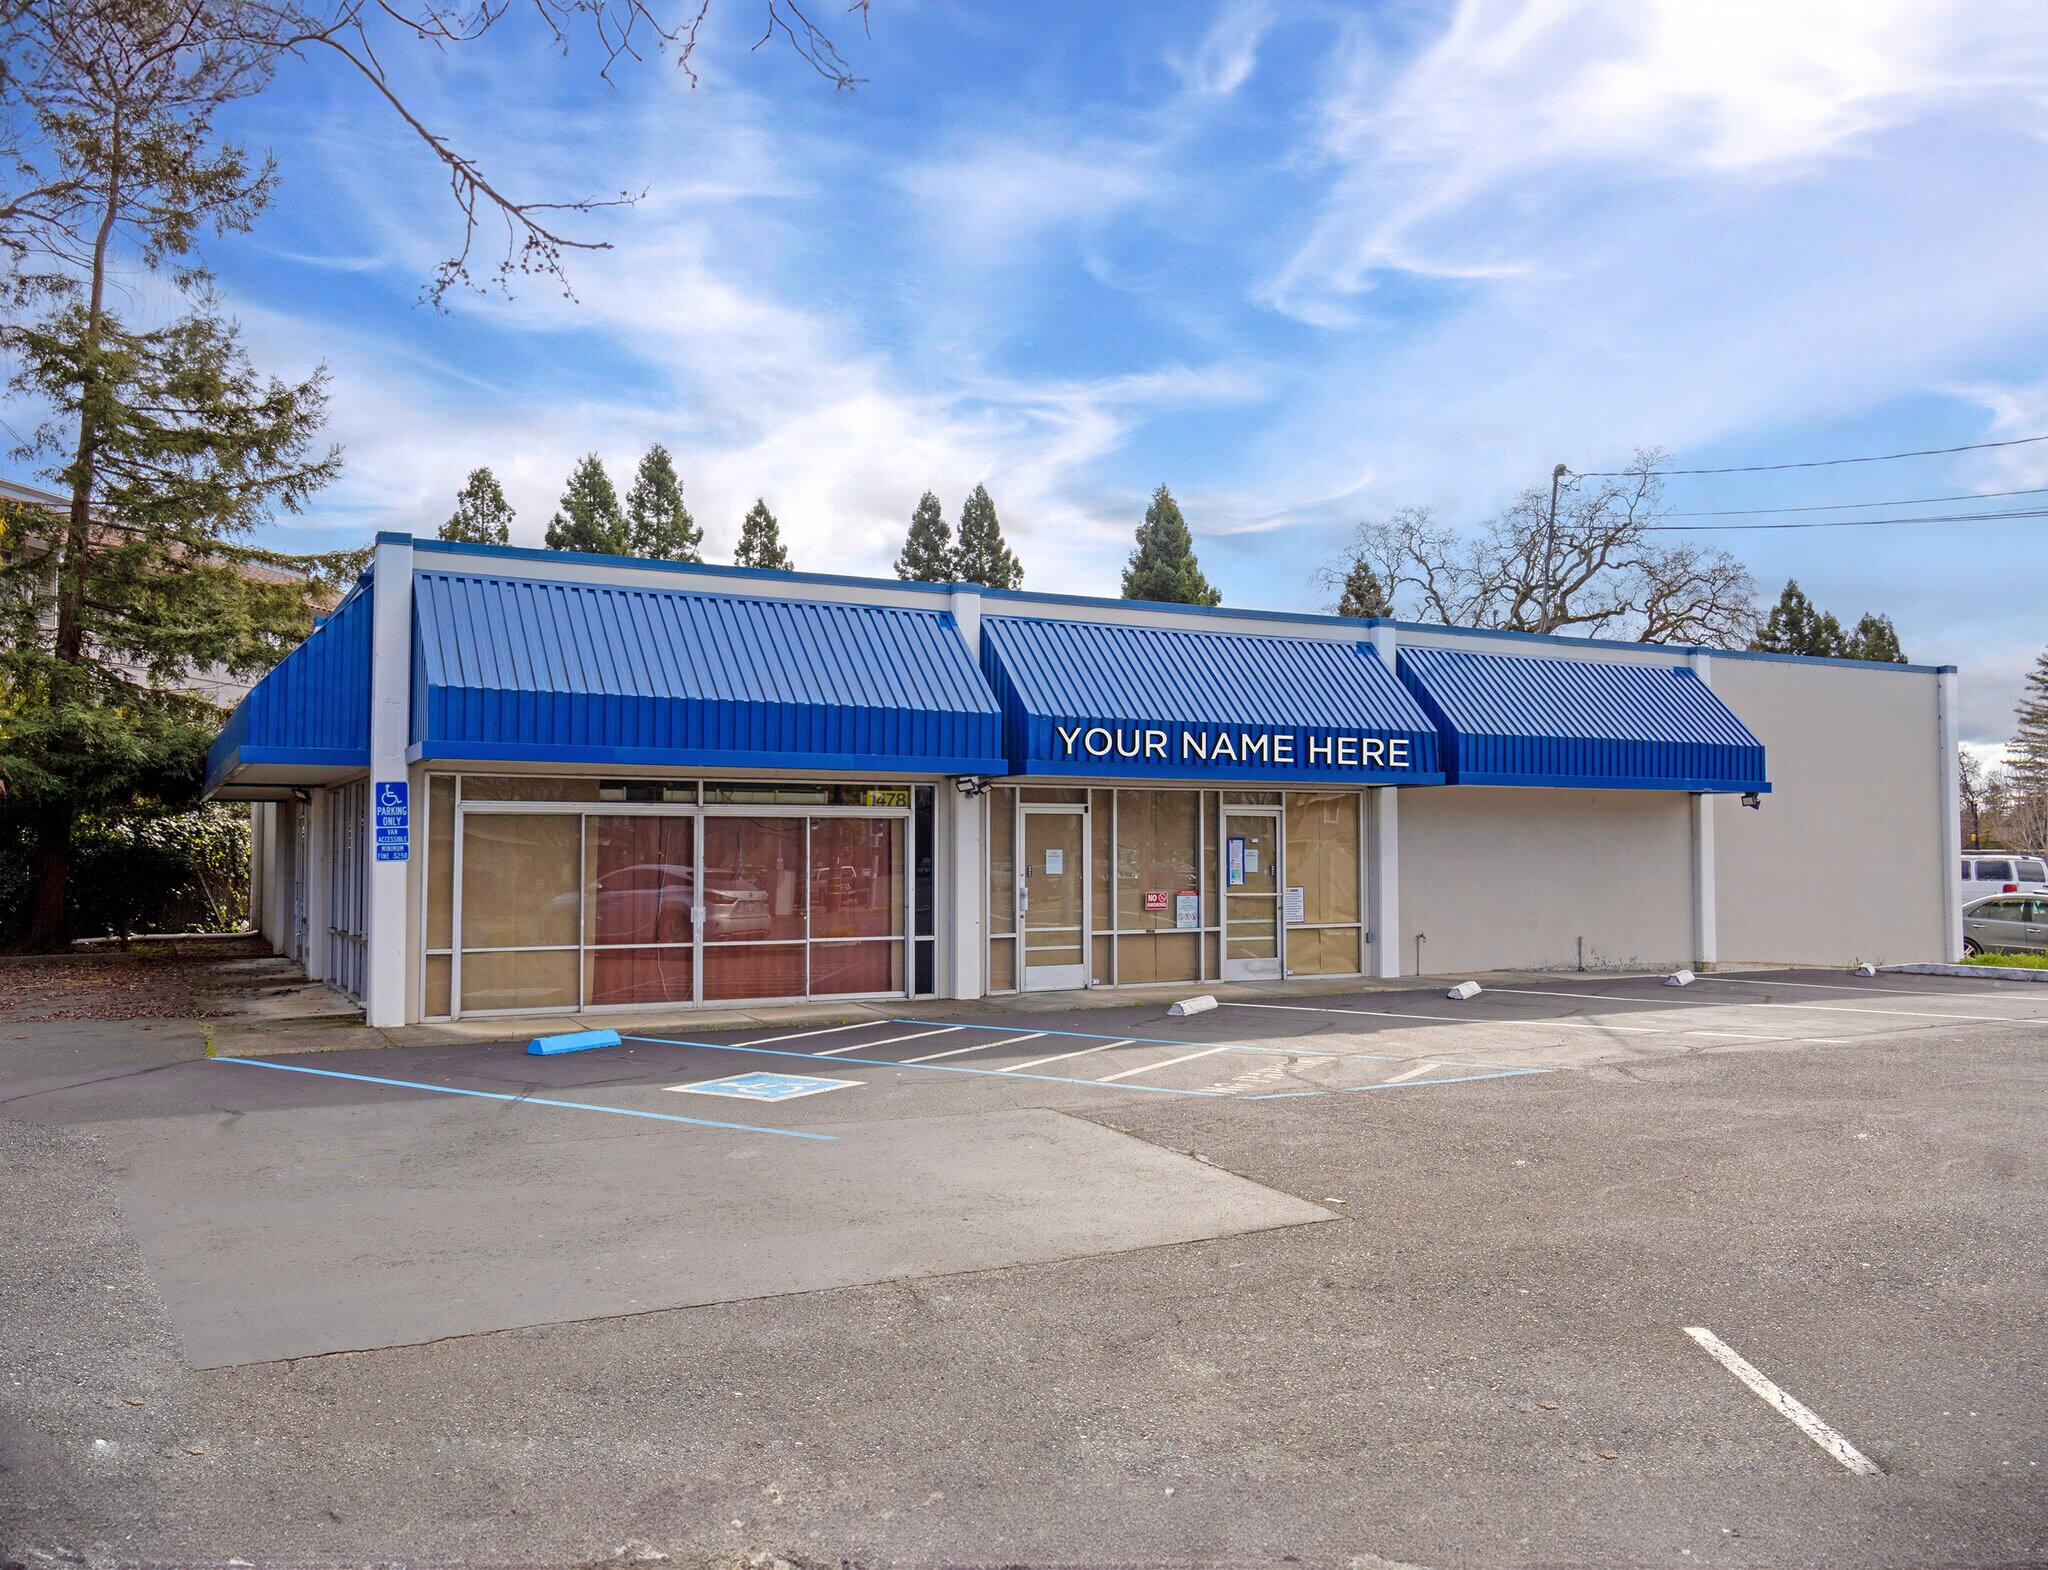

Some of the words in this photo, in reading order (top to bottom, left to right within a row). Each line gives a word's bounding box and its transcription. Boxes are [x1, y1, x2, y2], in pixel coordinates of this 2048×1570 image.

[1057, 726, 1168, 758] YOUR
[1182, 731, 1294, 763] NAME
[1308, 735, 1410, 767] HERE
[870, 792, 906, 807] 1478
[377, 807, 407, 816] PARKING
[382, 816, 402, 826] ONLY
[1147, 894, 1158, 902] NO
